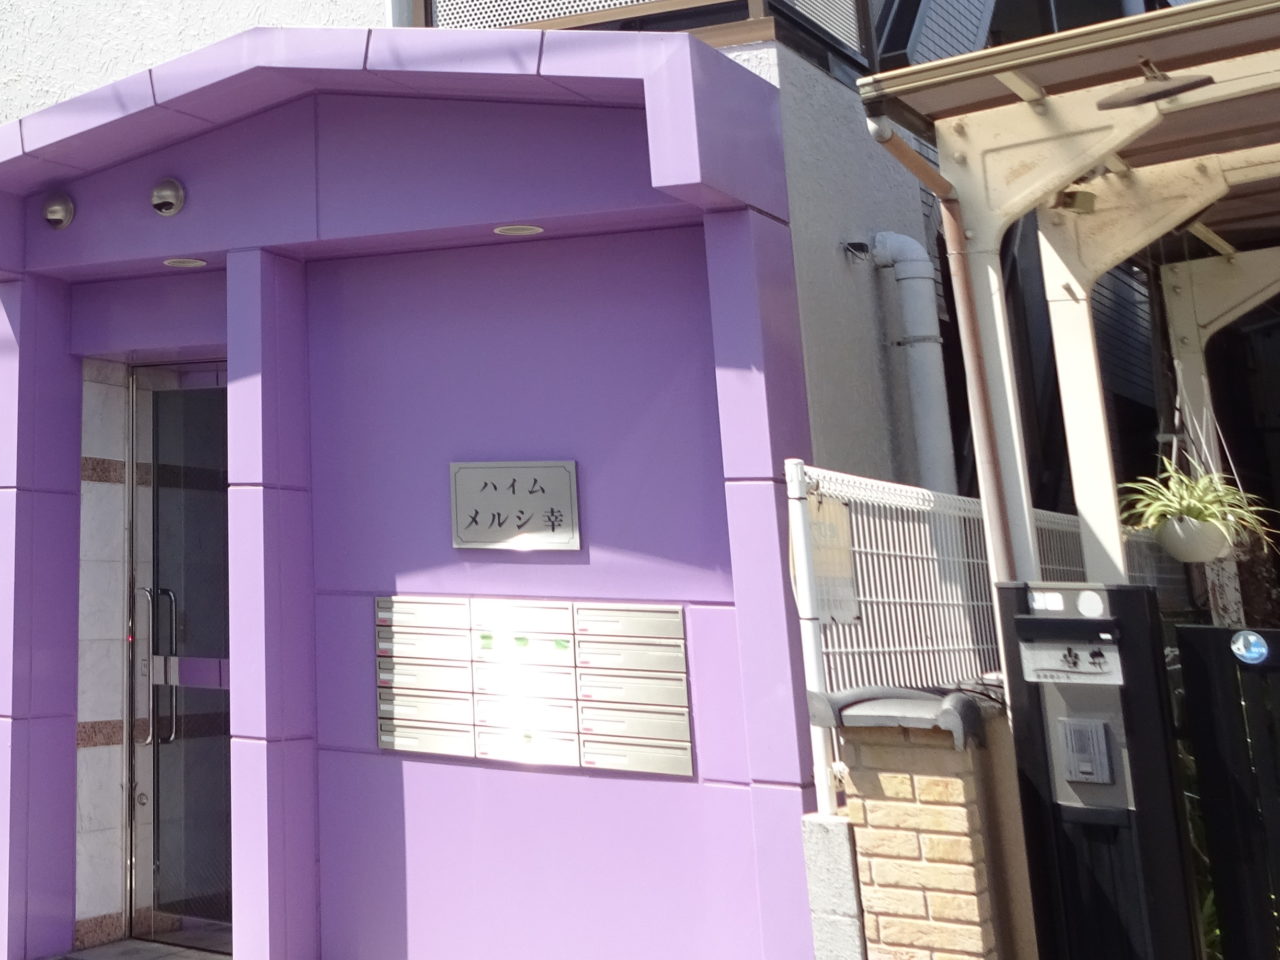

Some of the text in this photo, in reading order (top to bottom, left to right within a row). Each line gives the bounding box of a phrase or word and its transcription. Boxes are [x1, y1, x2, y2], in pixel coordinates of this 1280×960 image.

[480, 478, 546, 496] ハイム
[463, 506, 564, 533] メルシ幸
